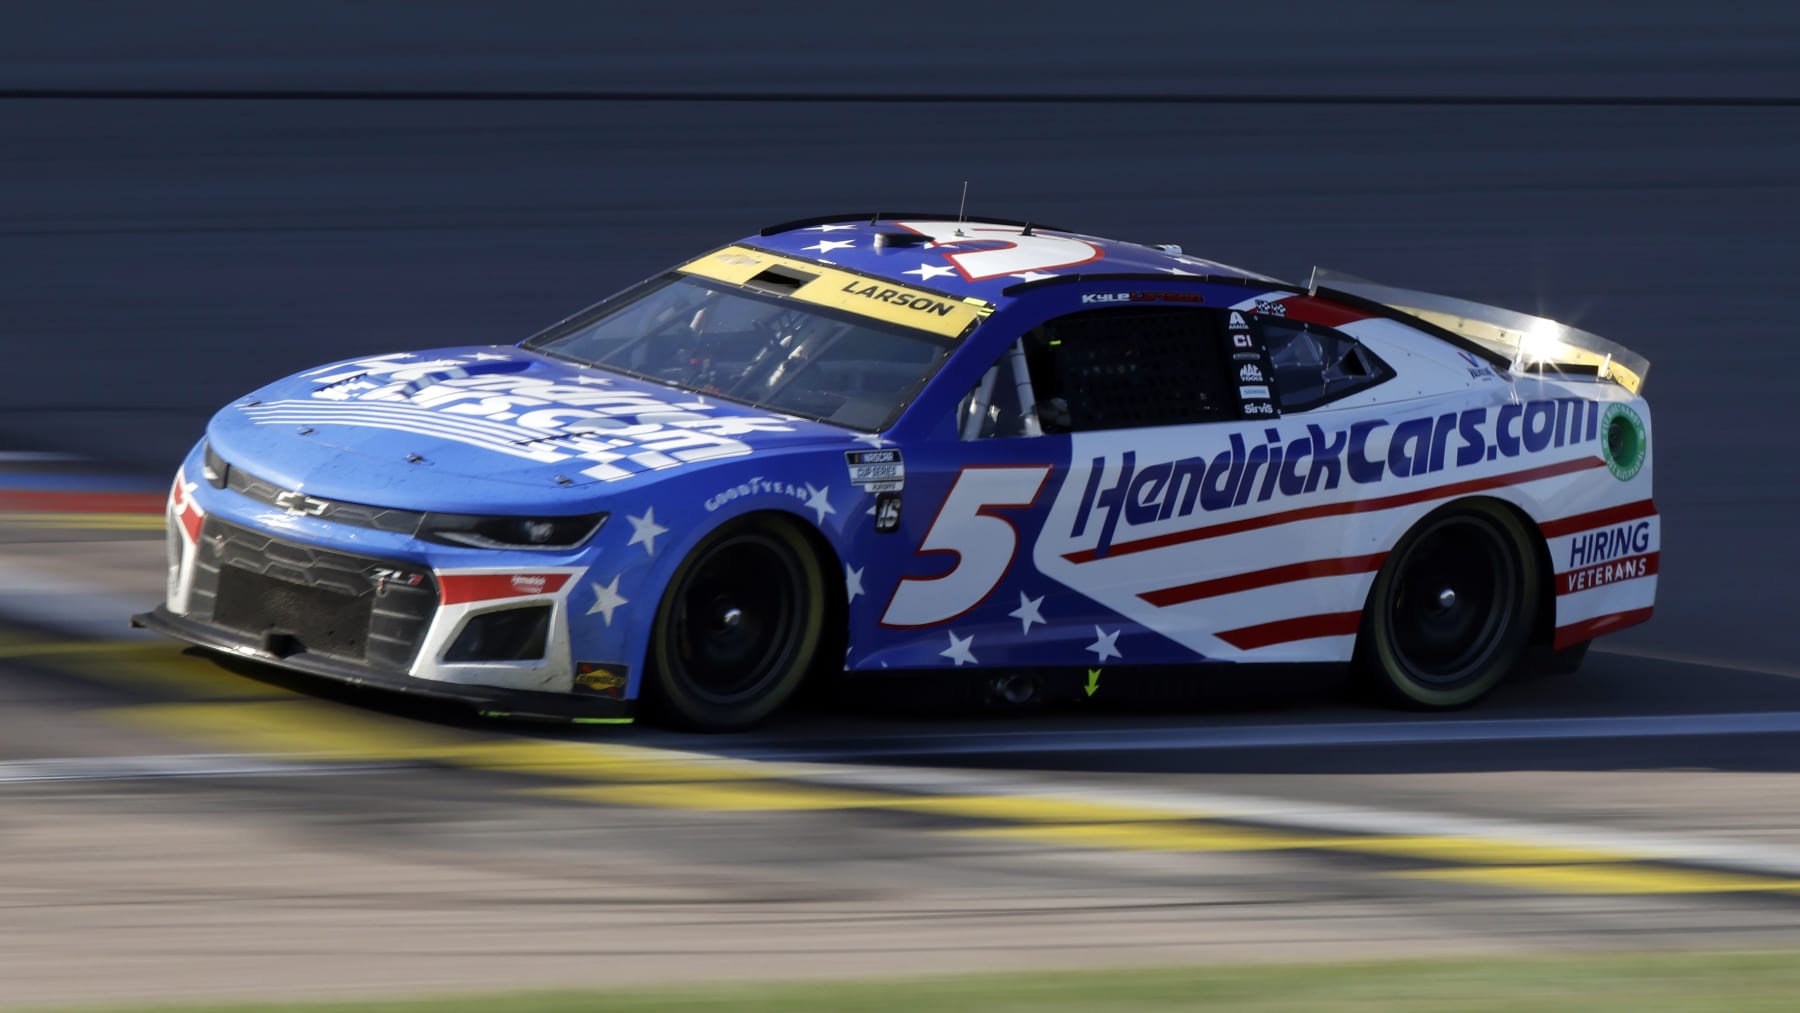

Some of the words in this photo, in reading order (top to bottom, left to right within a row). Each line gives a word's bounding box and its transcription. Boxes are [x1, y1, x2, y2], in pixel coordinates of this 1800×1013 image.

[842, 280, 956, 317] LARSON
[1081, 293, 1131, 304] KYLE
[704, 476, 808, 512] GOODYEAR
[1070, 399, 1599, 558] HendrickCars.com
[878, 463, 1054, 630] 5
[1569, 521, 1650, 569] HIRING
[1568, 558, 1648, 593] VETERANS
